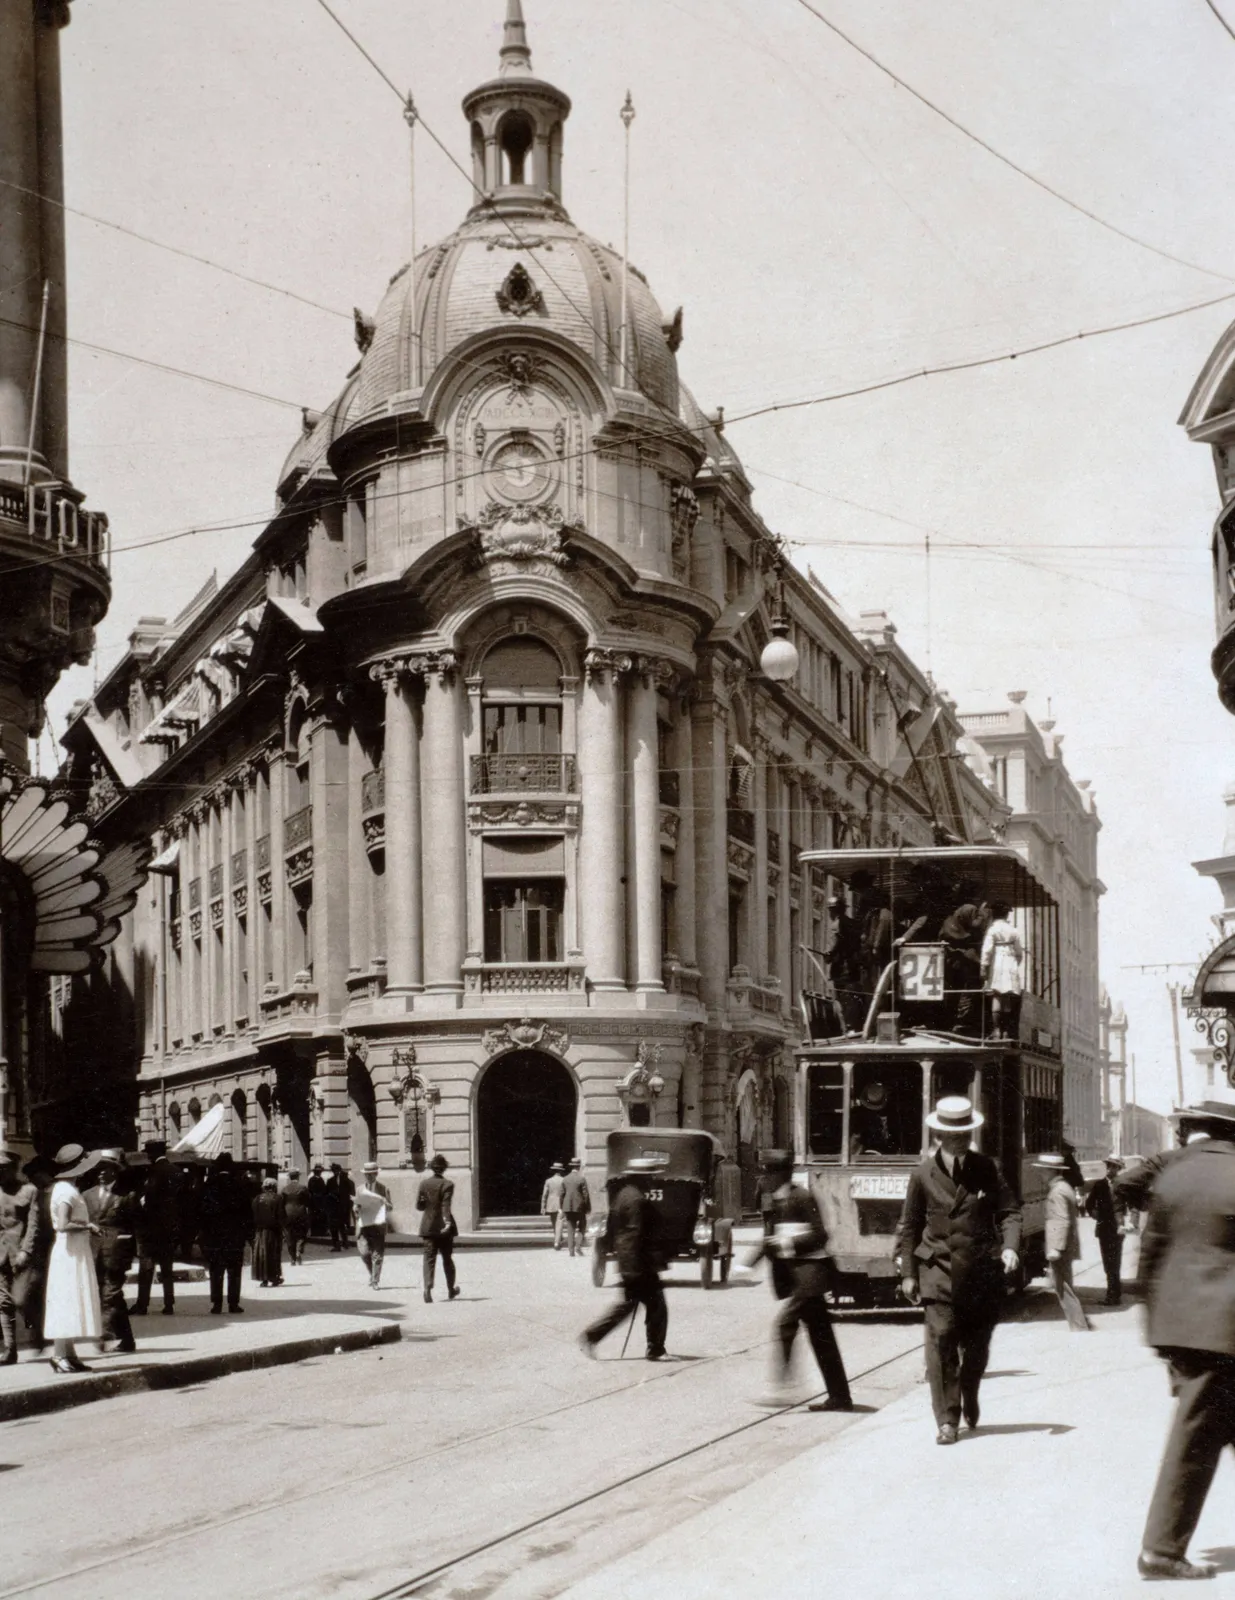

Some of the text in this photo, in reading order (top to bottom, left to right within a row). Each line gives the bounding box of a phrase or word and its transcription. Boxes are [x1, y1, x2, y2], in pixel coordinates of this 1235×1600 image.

[28, 484, 112, 582] HOT
[899, 953, 943, 996] 24
[852, 1178, 909, 1194] MATADER
